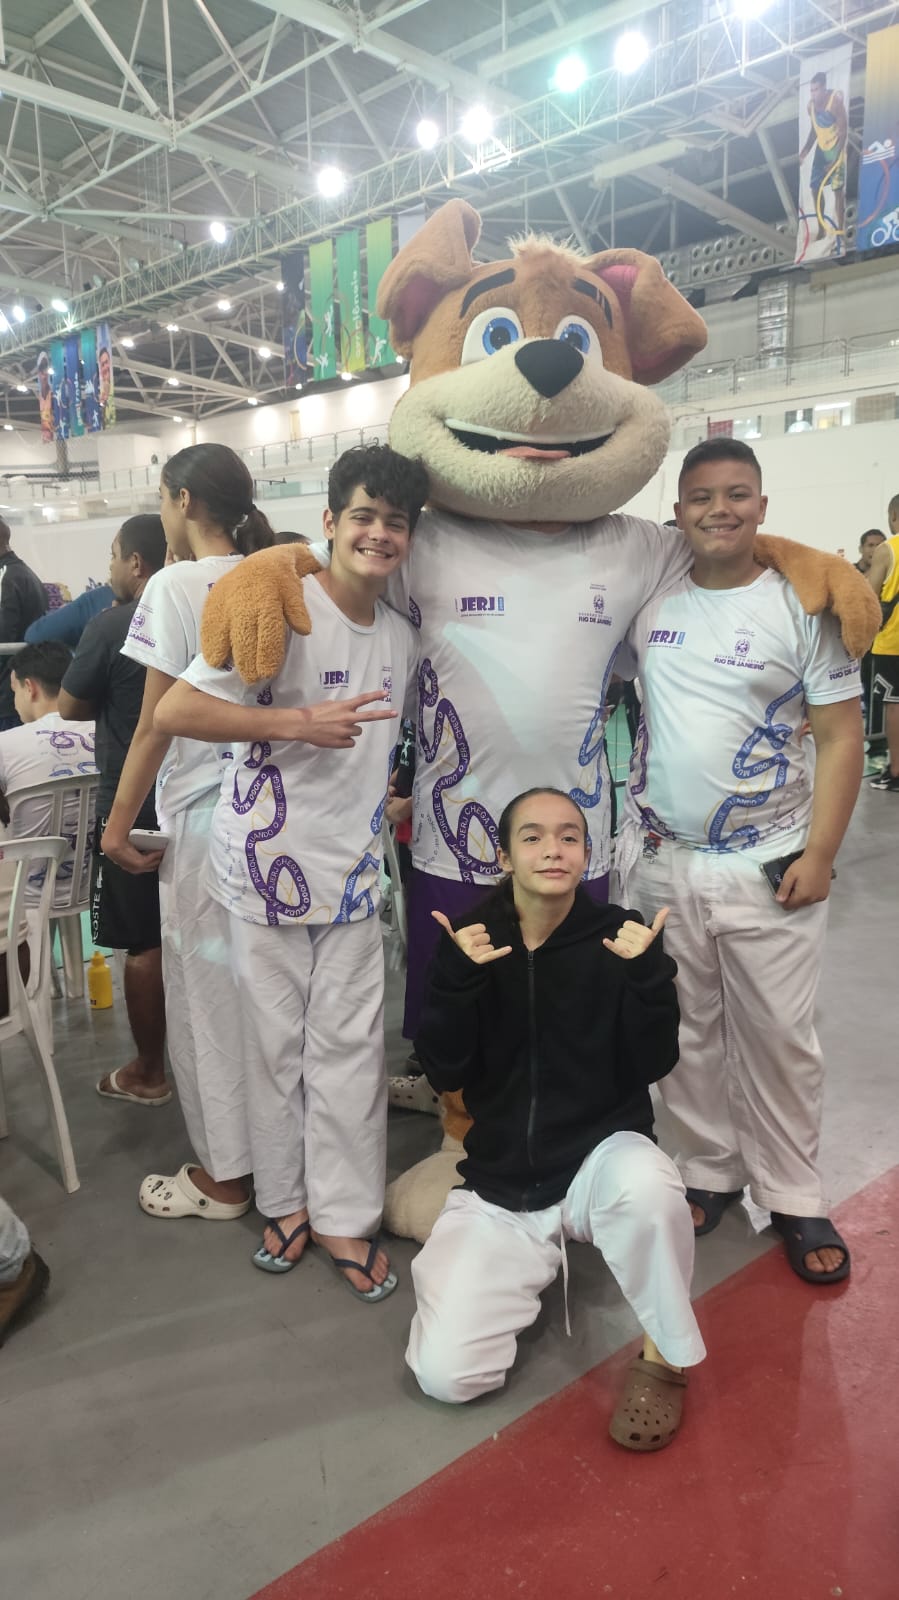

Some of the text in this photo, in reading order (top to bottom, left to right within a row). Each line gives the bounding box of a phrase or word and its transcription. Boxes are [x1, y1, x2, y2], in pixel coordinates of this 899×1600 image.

[461, 597, 495, 612] JERJ
[648, 630, 677, 643] JERJ
[323, 670, 346, 685] JER
[434, 774, 458, 799] QUANDO
[434, 802, 450, 839] PORQUE
[460, 816, 469, 840] JERJ
[247, 829, 274, 849] QUANDO
